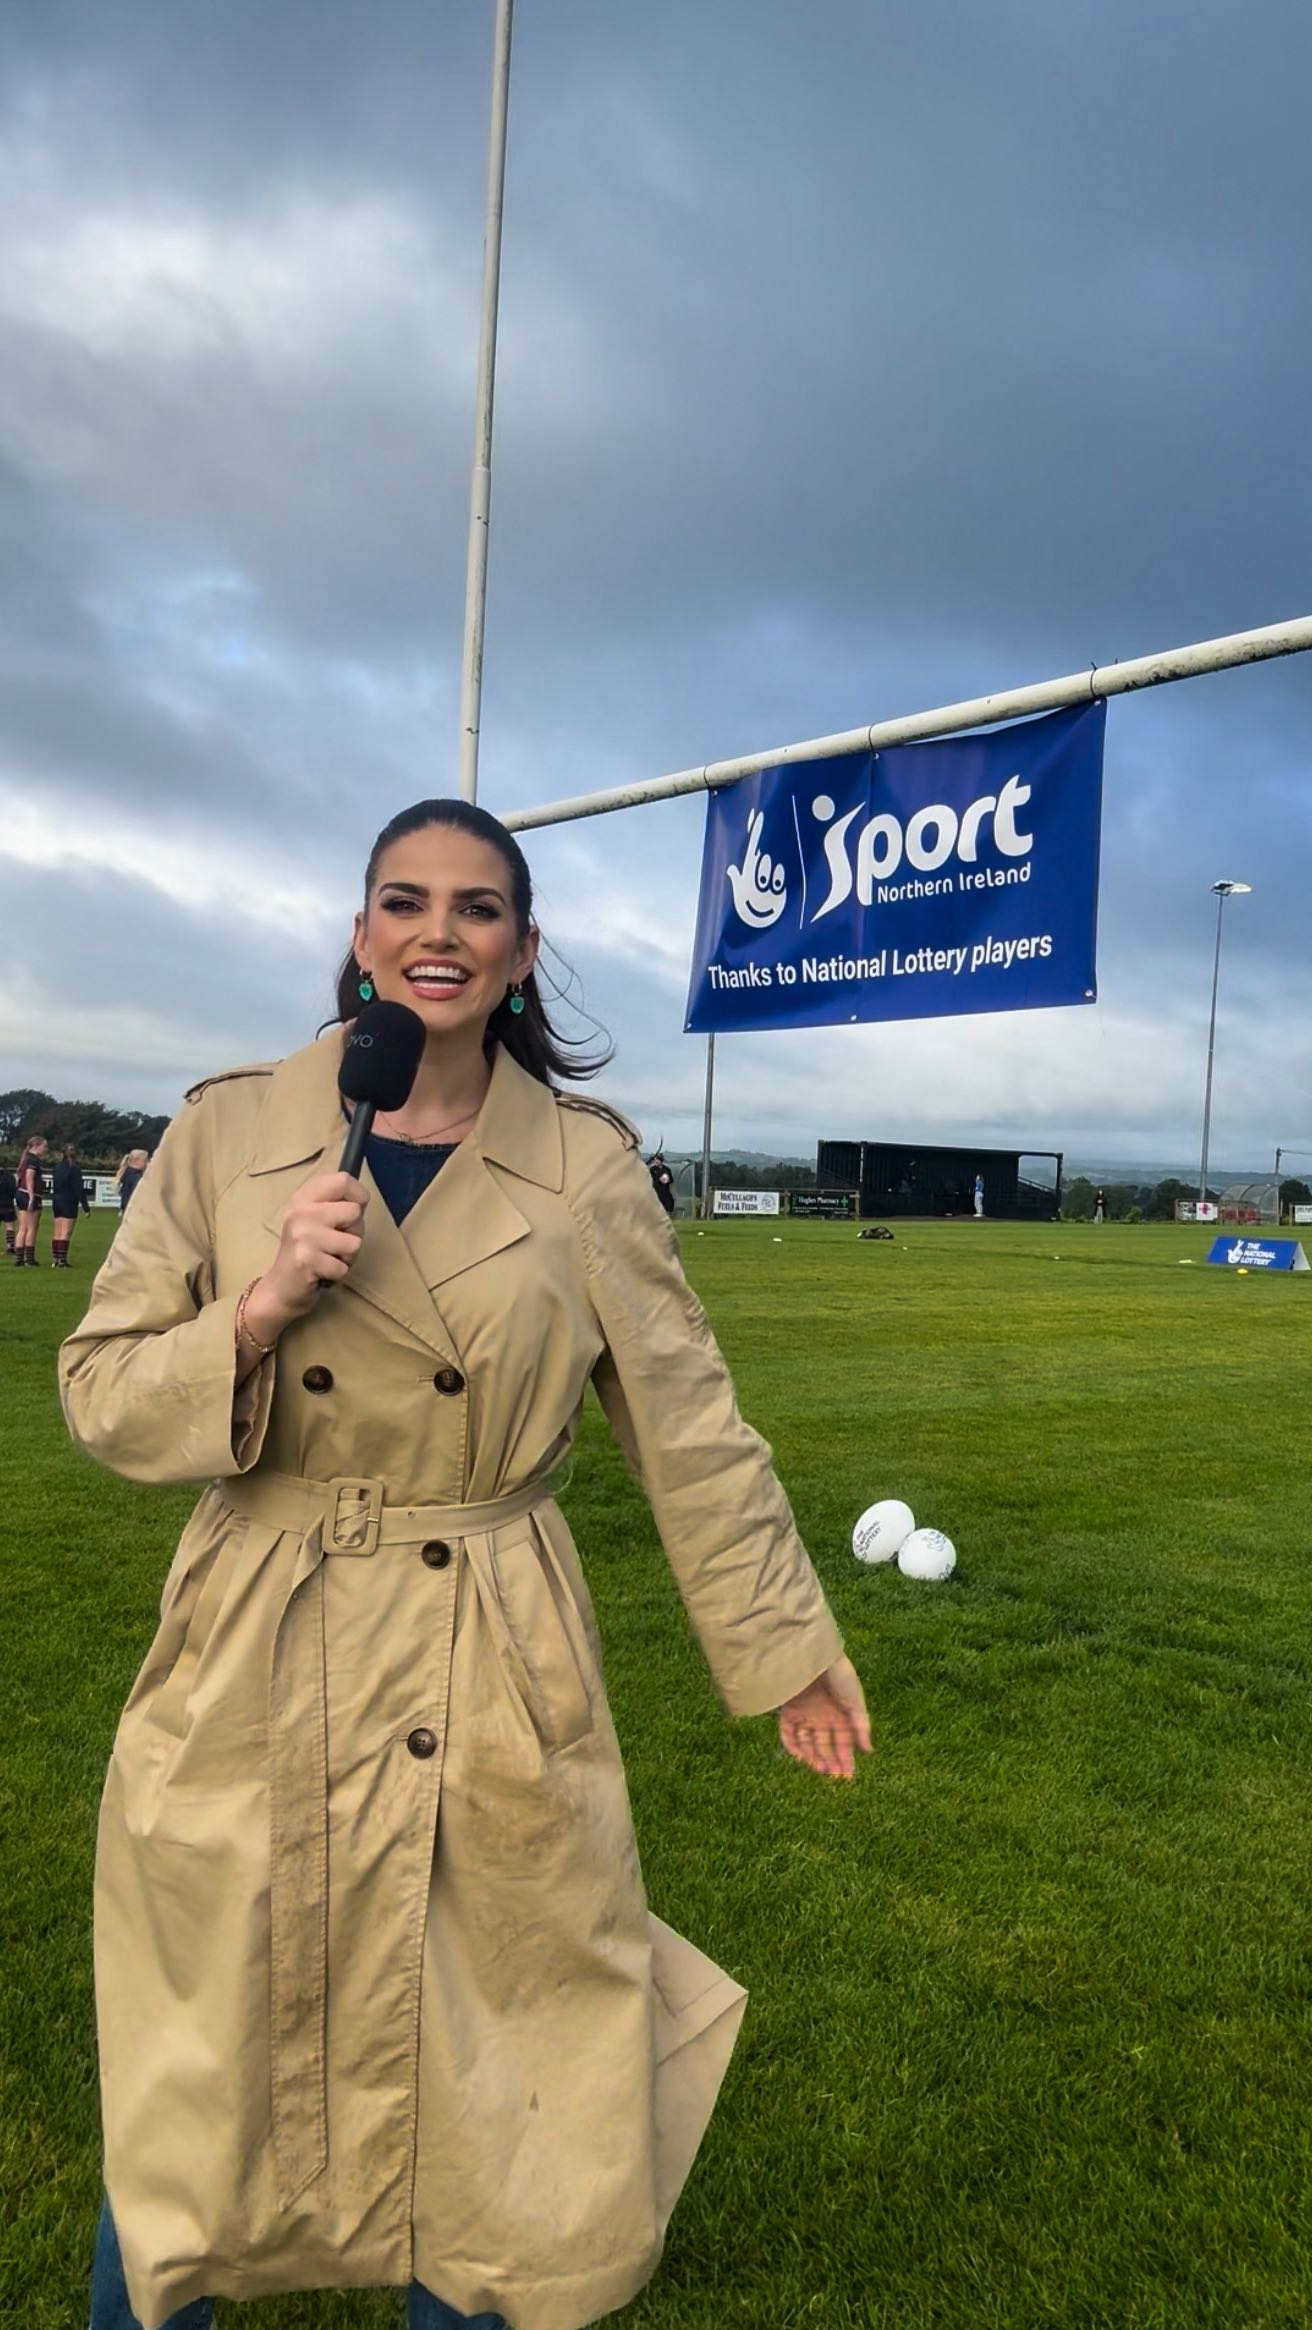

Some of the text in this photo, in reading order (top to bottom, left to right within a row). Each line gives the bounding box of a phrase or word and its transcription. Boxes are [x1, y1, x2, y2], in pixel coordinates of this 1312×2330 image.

[810, 774, 1033, 923] Sport
[877, 862, 1032, 904] Northern Ireland
[708, 934, 1053, 990] Thanks to National Lottery players
[1244, 1251, 1276, 1259] NATIONAL
[1247, 1242, 1261, 1250] THE
